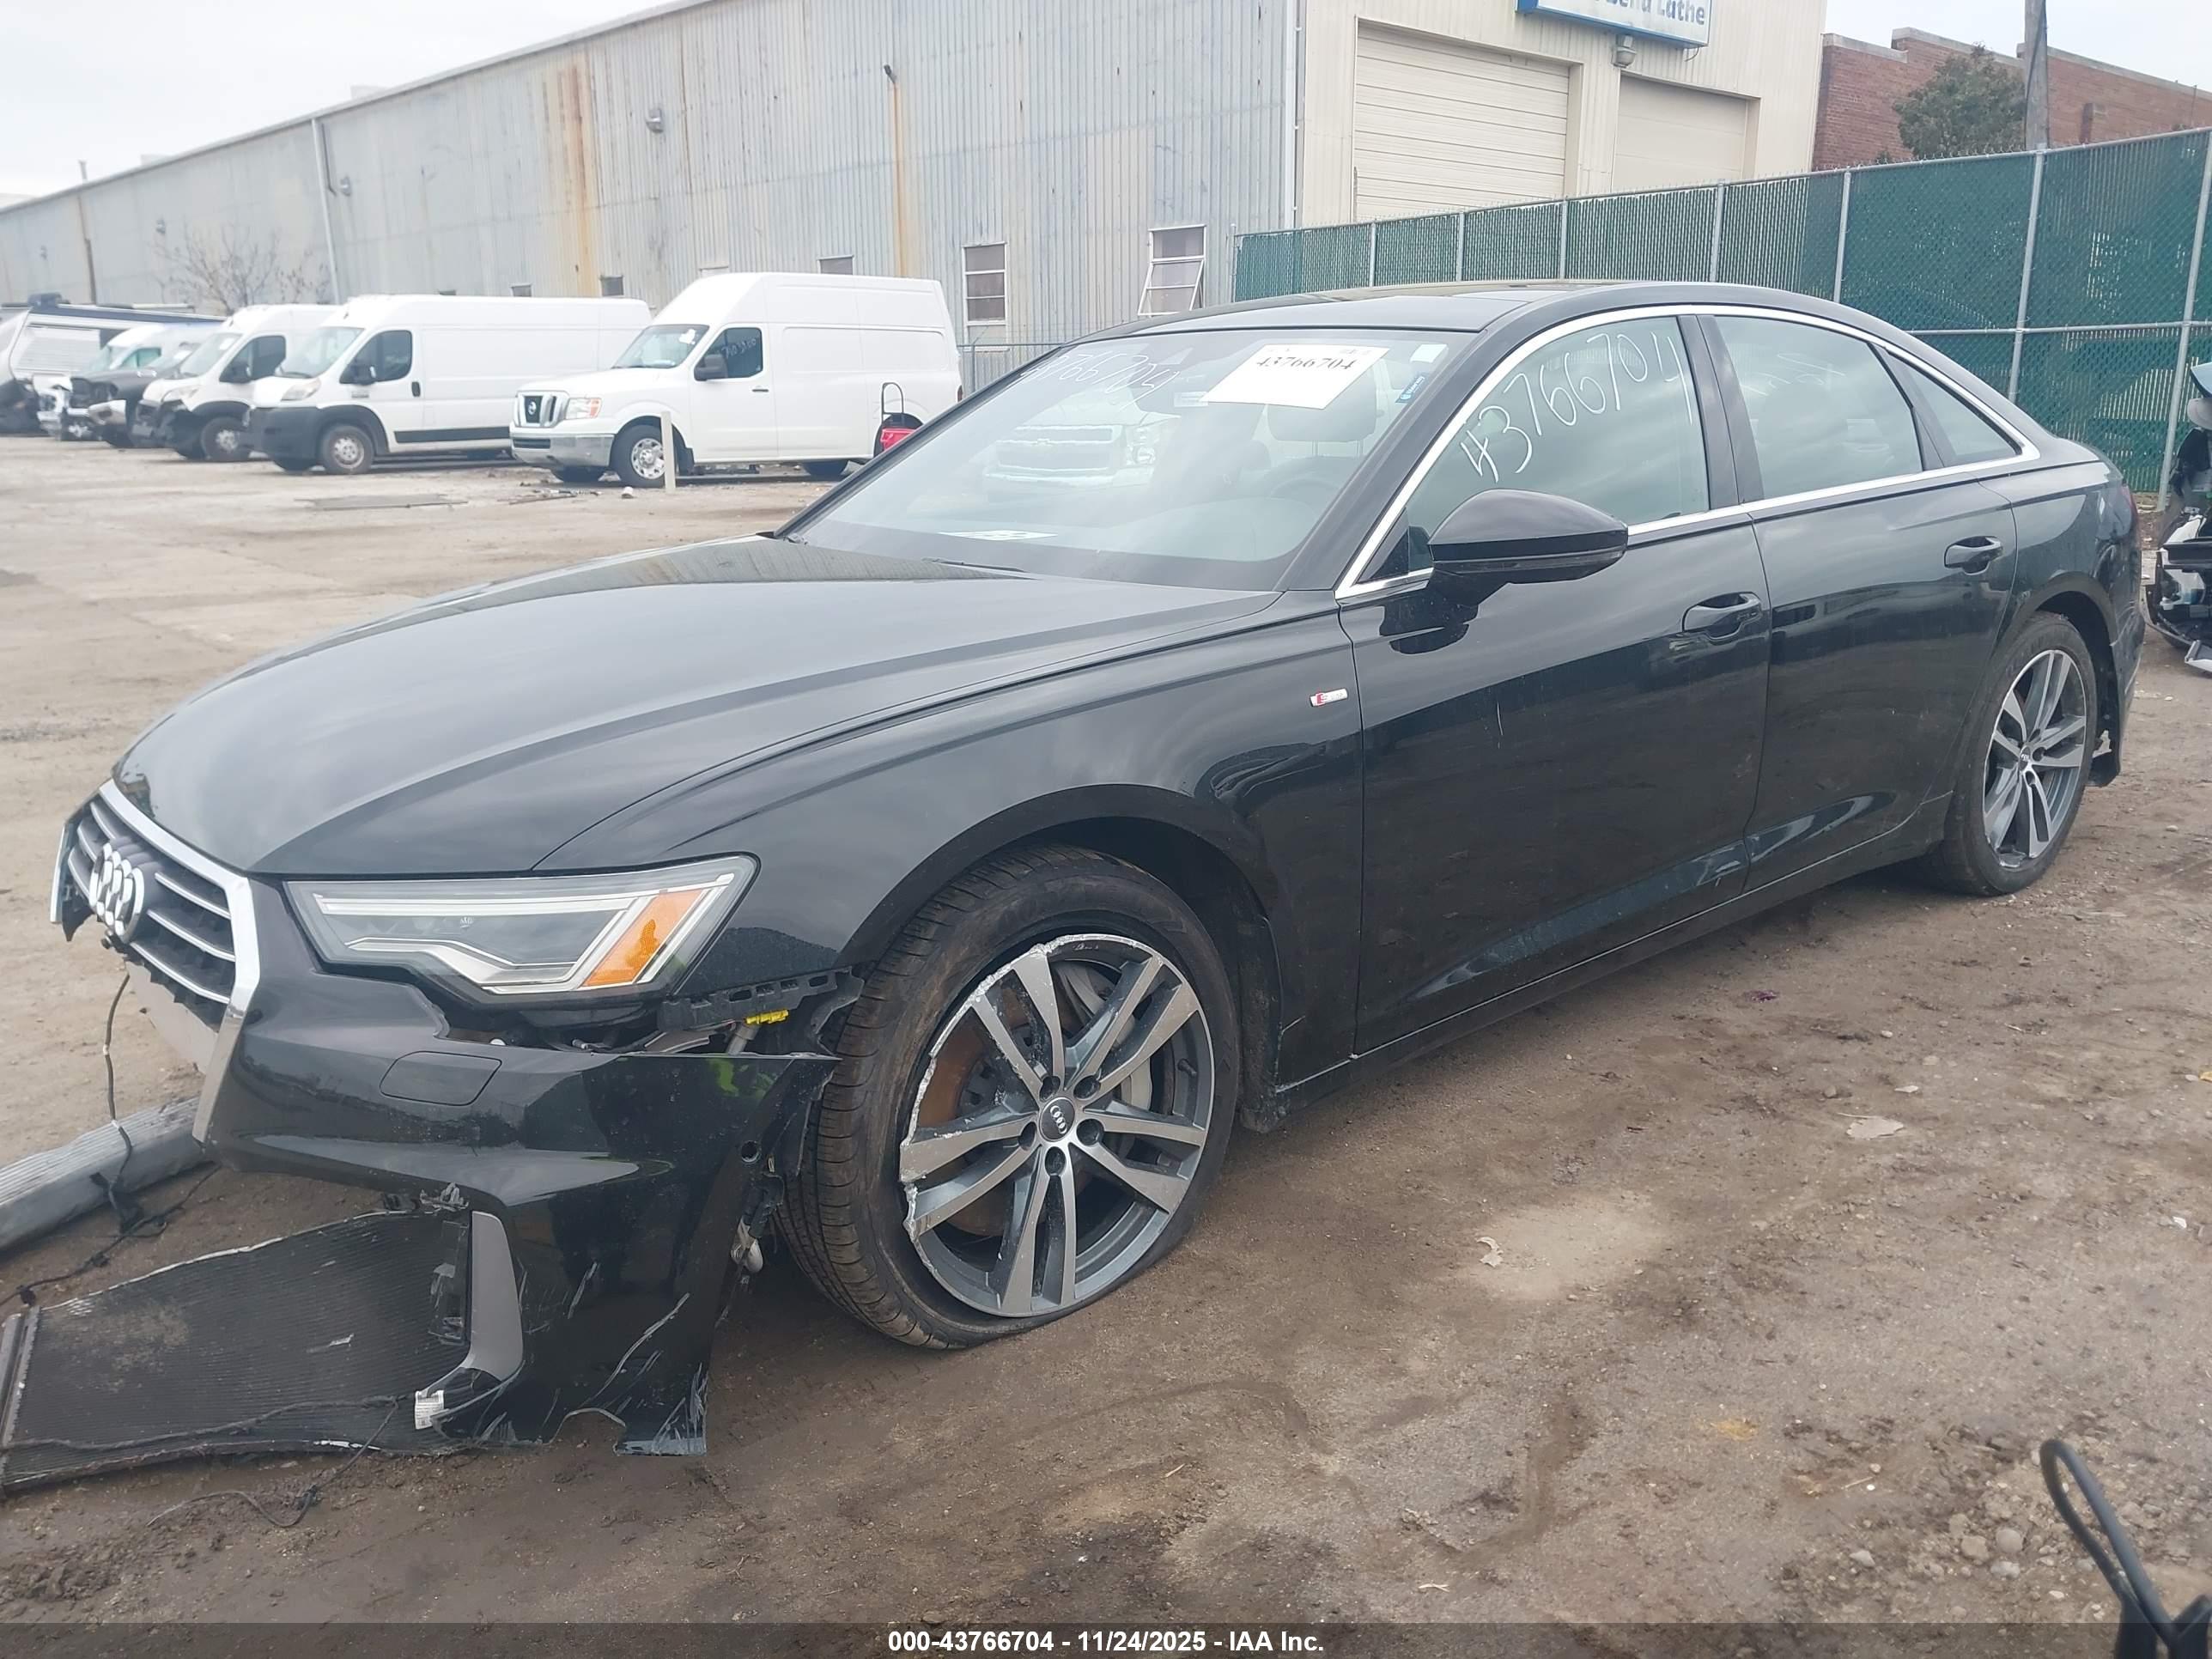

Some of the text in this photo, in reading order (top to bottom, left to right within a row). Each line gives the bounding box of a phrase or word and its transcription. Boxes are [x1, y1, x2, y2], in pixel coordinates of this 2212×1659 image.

[1656, 0, 1705, 25] Lathe
[1256, 356, 1358, 370] 43766704
[1460, 331, 1692, 483] 43766704
